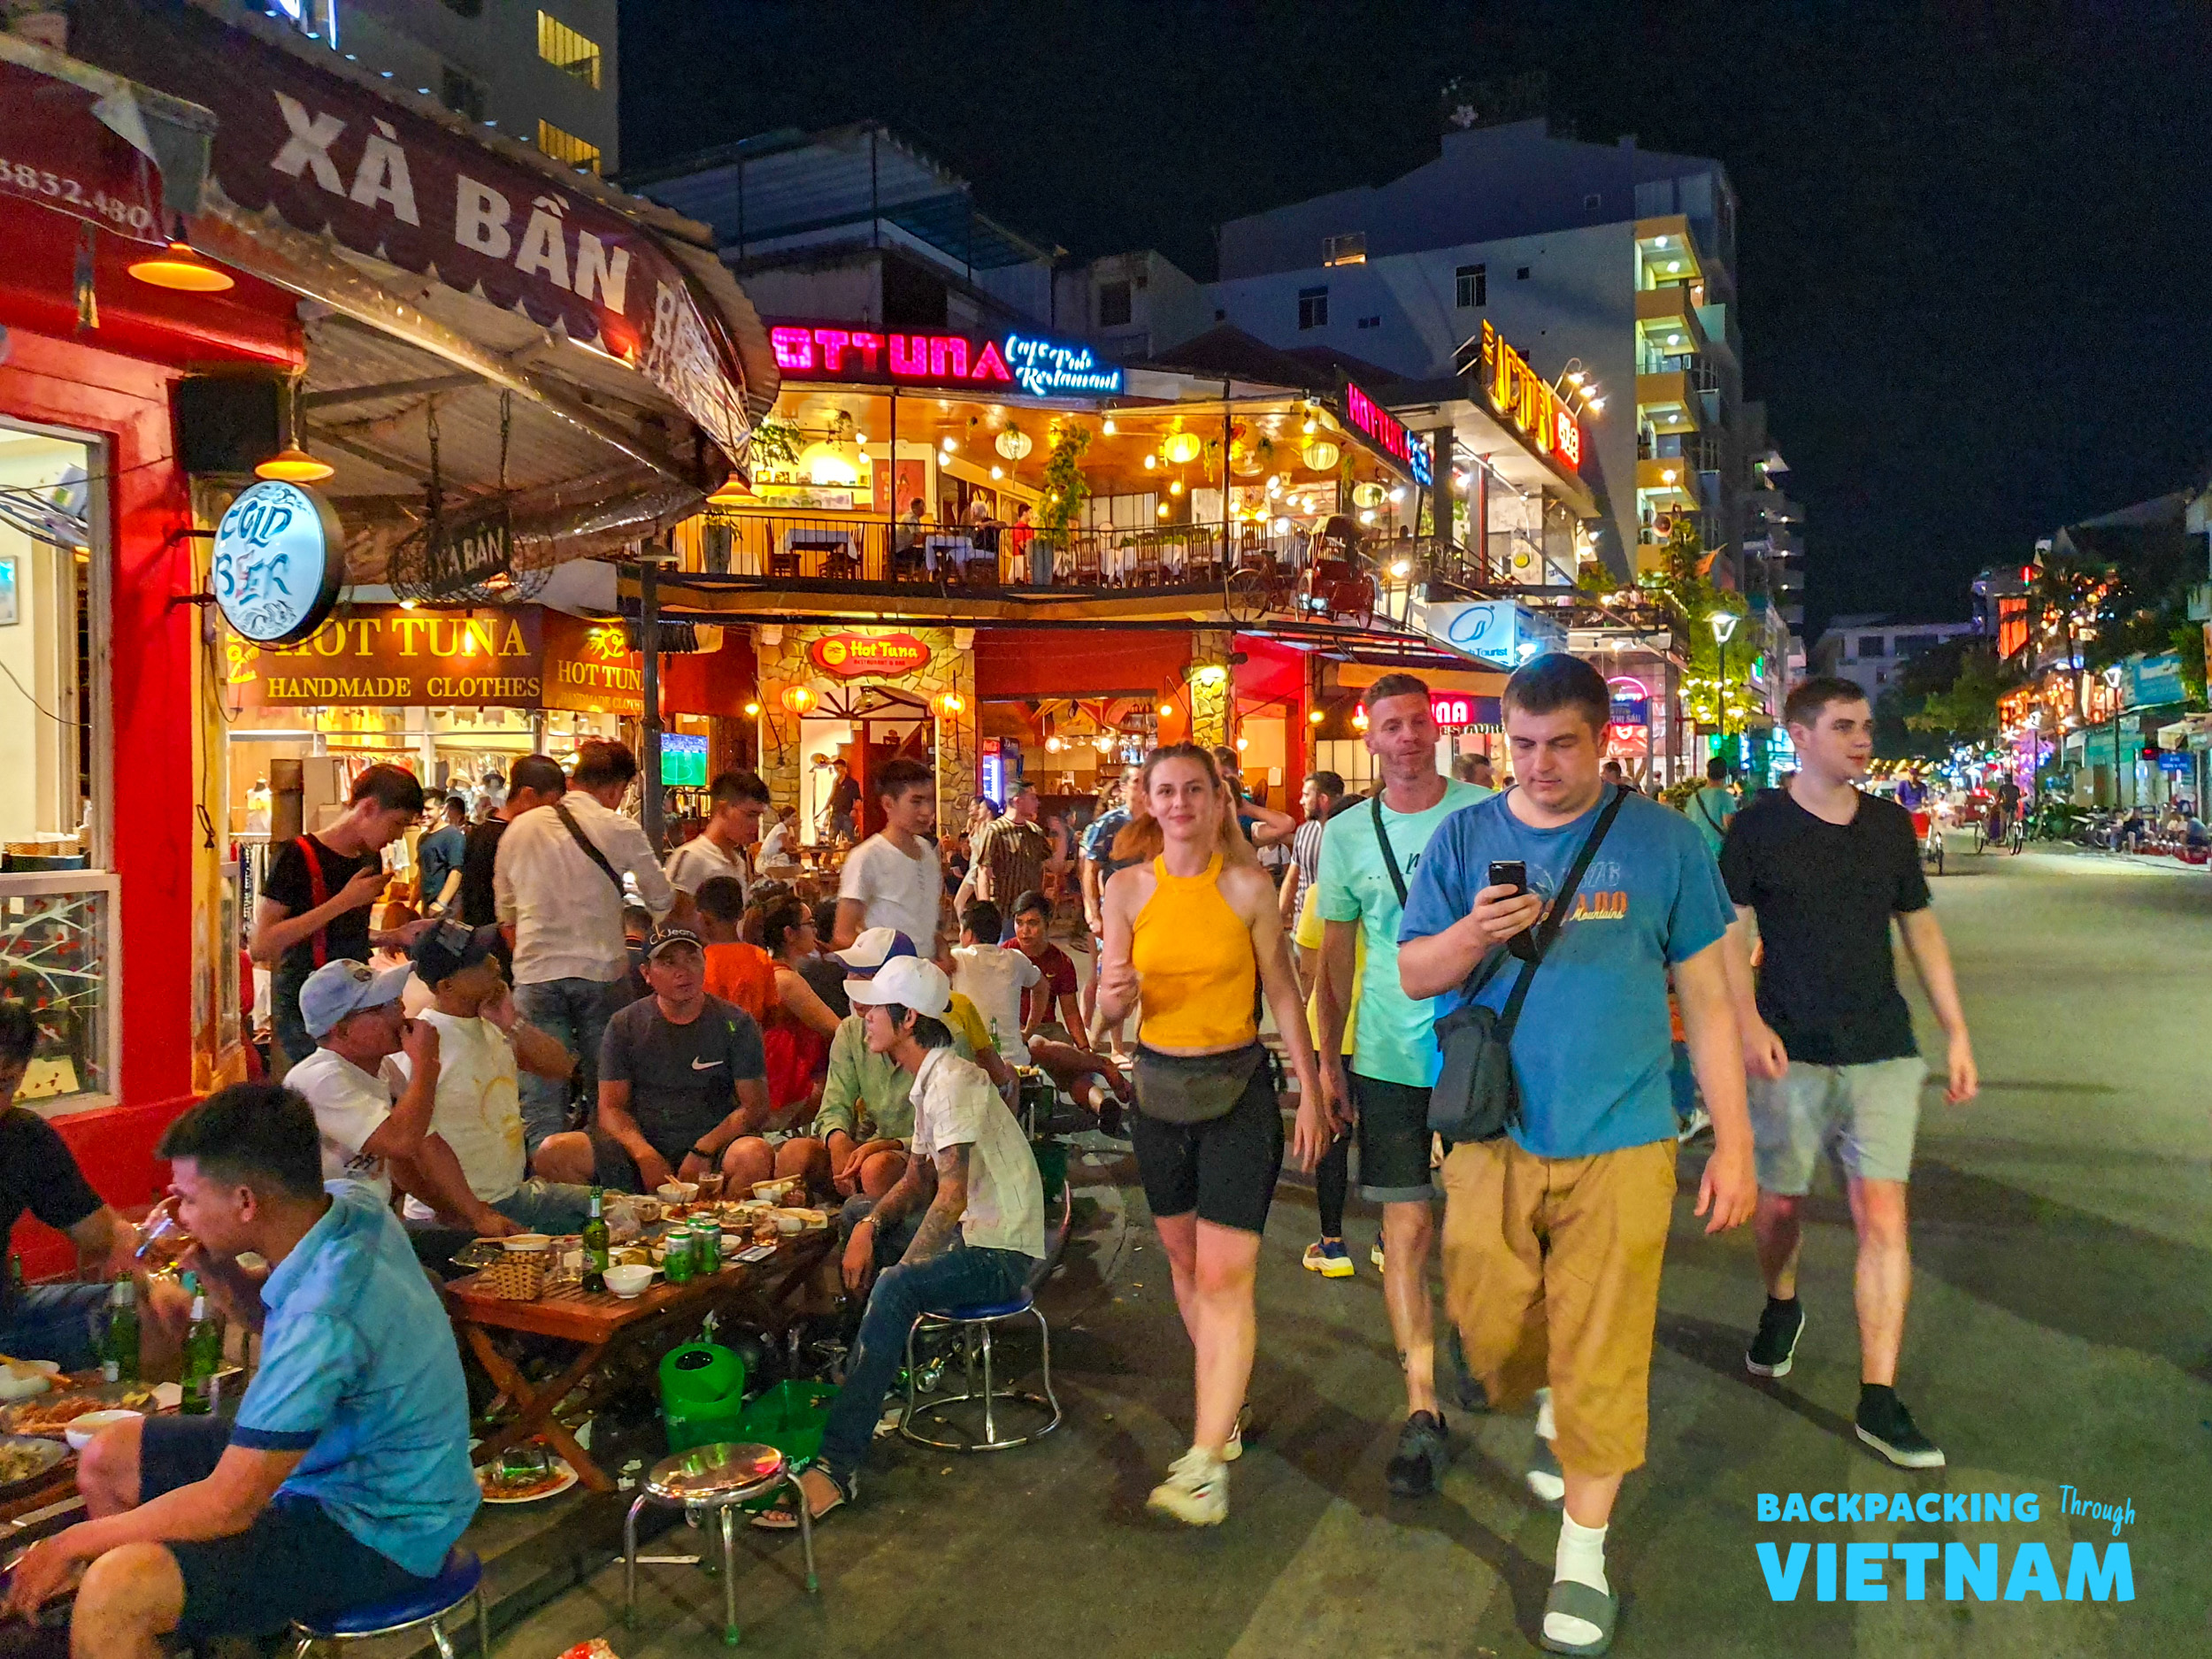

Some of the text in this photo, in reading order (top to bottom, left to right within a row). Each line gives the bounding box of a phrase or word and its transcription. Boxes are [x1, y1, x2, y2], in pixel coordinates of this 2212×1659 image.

[271, 89, 420, 227] XÀ
[220, 500, 293, 548] COLD
[216, 549, 293, 606] BEER
[392, 618, 530, 657] TUNA
[850, 641, 918, 658] Hot Tuna
[267, 677, 541, 697] HANDMADE CLOTHES
[557, 659, 644, 691] HOT TUN
[612, 696, 644, 711] CLOTH
[1569, 907, 1624, 922] Mountains
